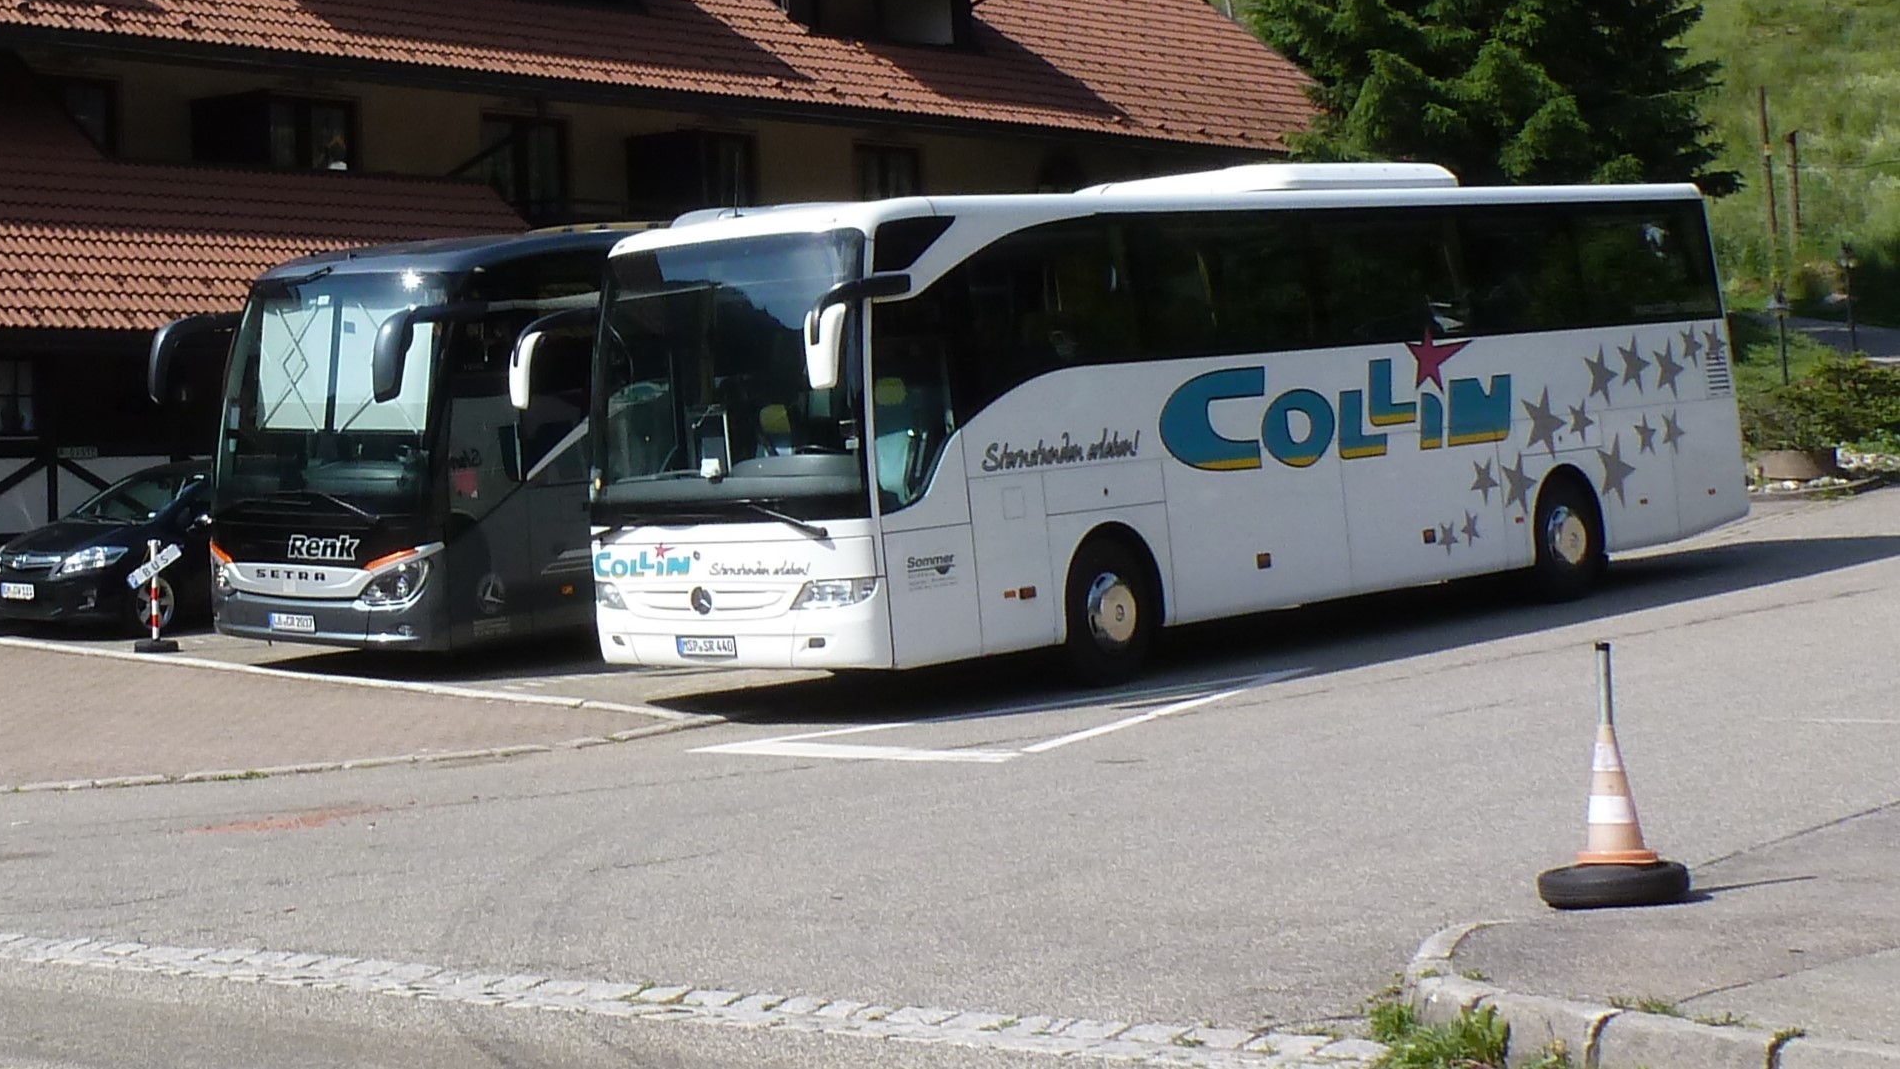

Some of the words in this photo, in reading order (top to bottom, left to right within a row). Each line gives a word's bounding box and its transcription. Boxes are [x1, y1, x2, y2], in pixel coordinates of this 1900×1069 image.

[287, 534, 360, 560] Renk
[142, 555, 169, 578] BUS
[907, 554, 954, 569] Sommer
[256, 568, 326, 581] SETRA
[716, 640, 733, 652] 440
